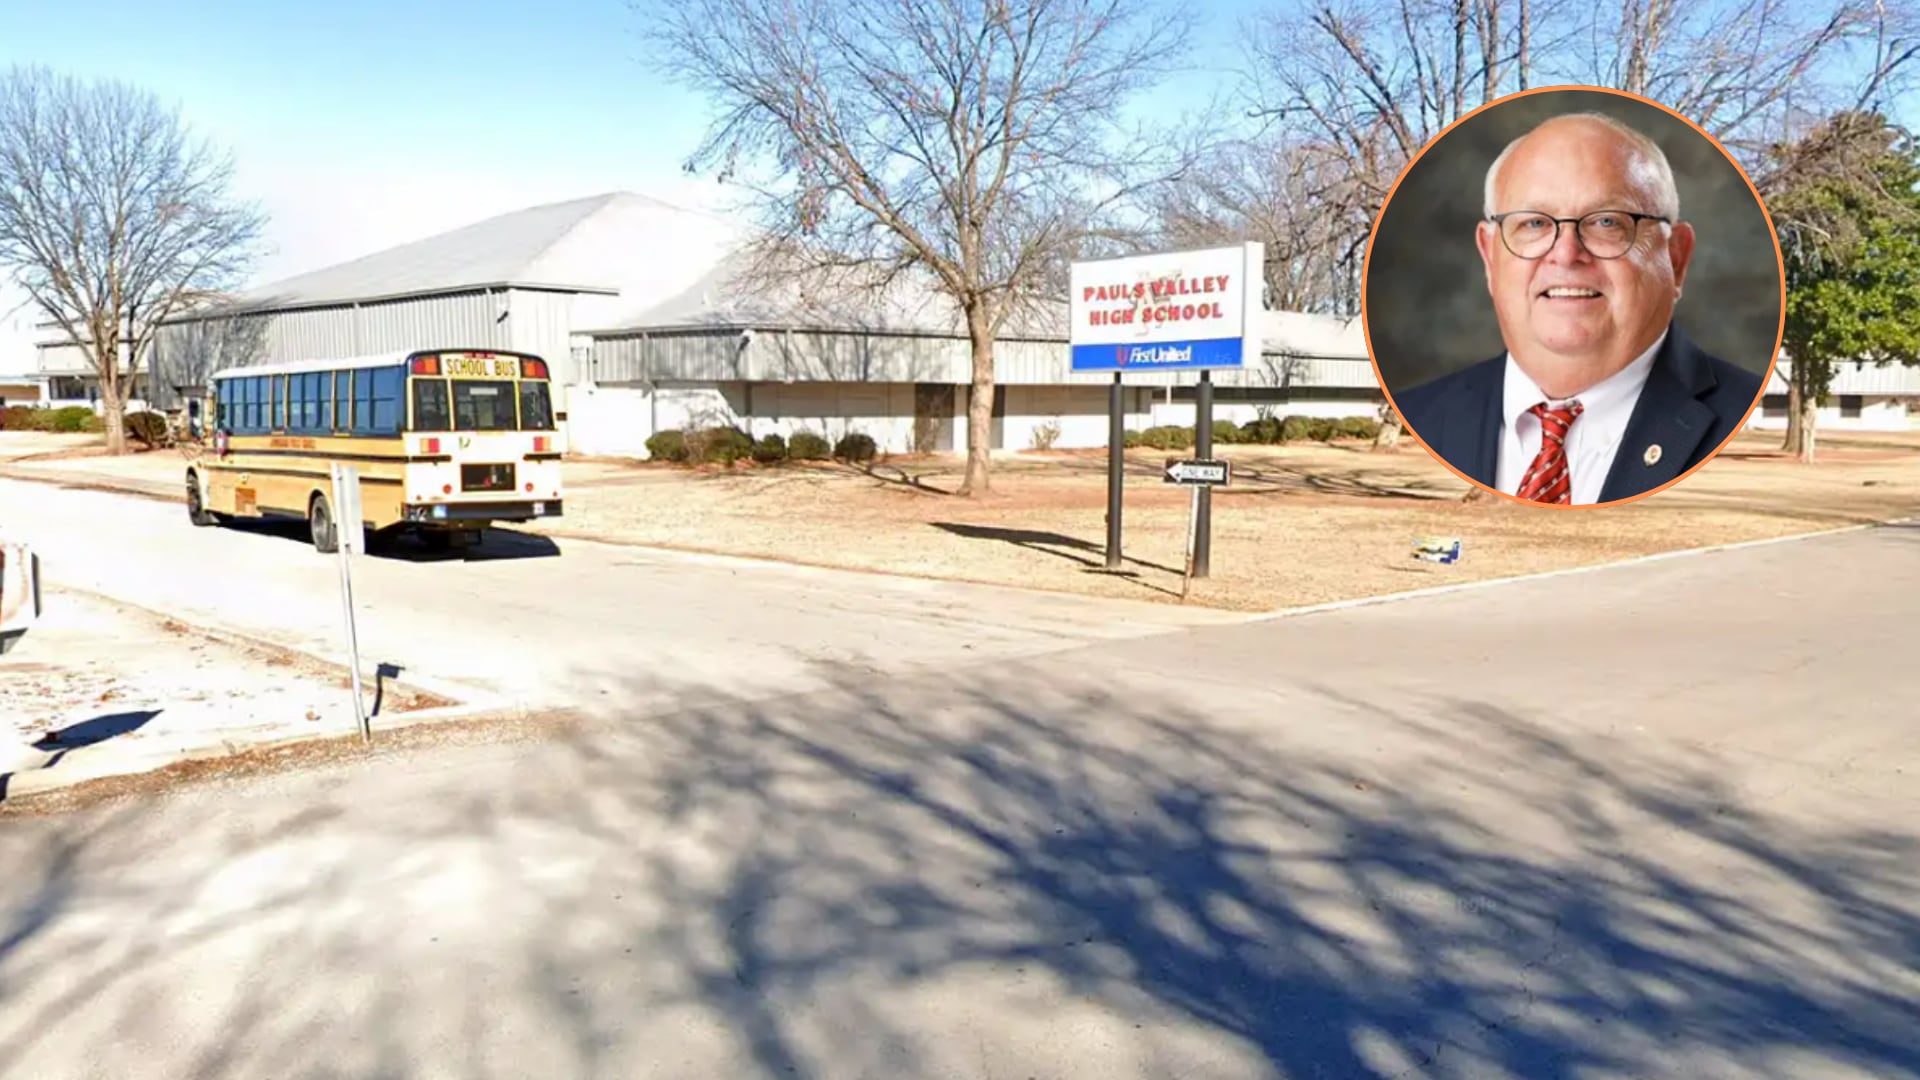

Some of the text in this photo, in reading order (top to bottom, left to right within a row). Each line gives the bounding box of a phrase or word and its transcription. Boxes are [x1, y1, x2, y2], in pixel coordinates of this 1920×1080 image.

[1083, 275, 1229, 302] PAULS VALLEY
[1089, 302, 1223, 326] HIGH SCHOOL
[446, 358, 516, 376] SCHOOL BUS
